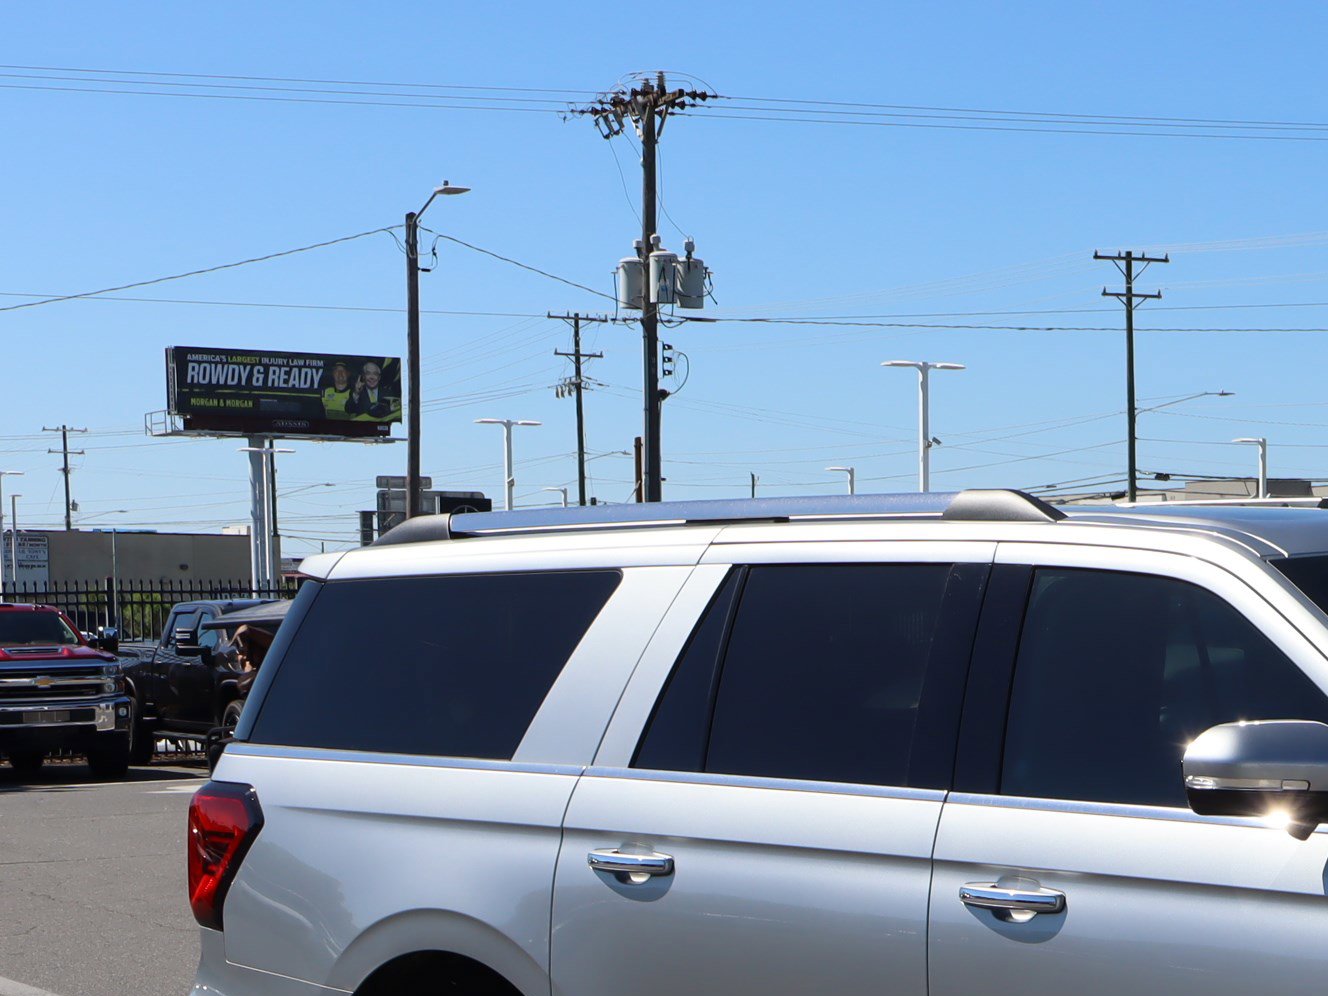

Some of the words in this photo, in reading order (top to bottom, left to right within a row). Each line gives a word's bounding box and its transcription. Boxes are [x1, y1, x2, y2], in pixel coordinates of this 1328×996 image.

[187, 354, 227, 362] AMERICA'S
[187, 362, 251, 386] ROWDY
[252, 366, 265, 387] &
[268, 366, 323, 389] READY
[191, 398, 218, 407] MORGAN
[226, 400, 253, 408] MORGAN
